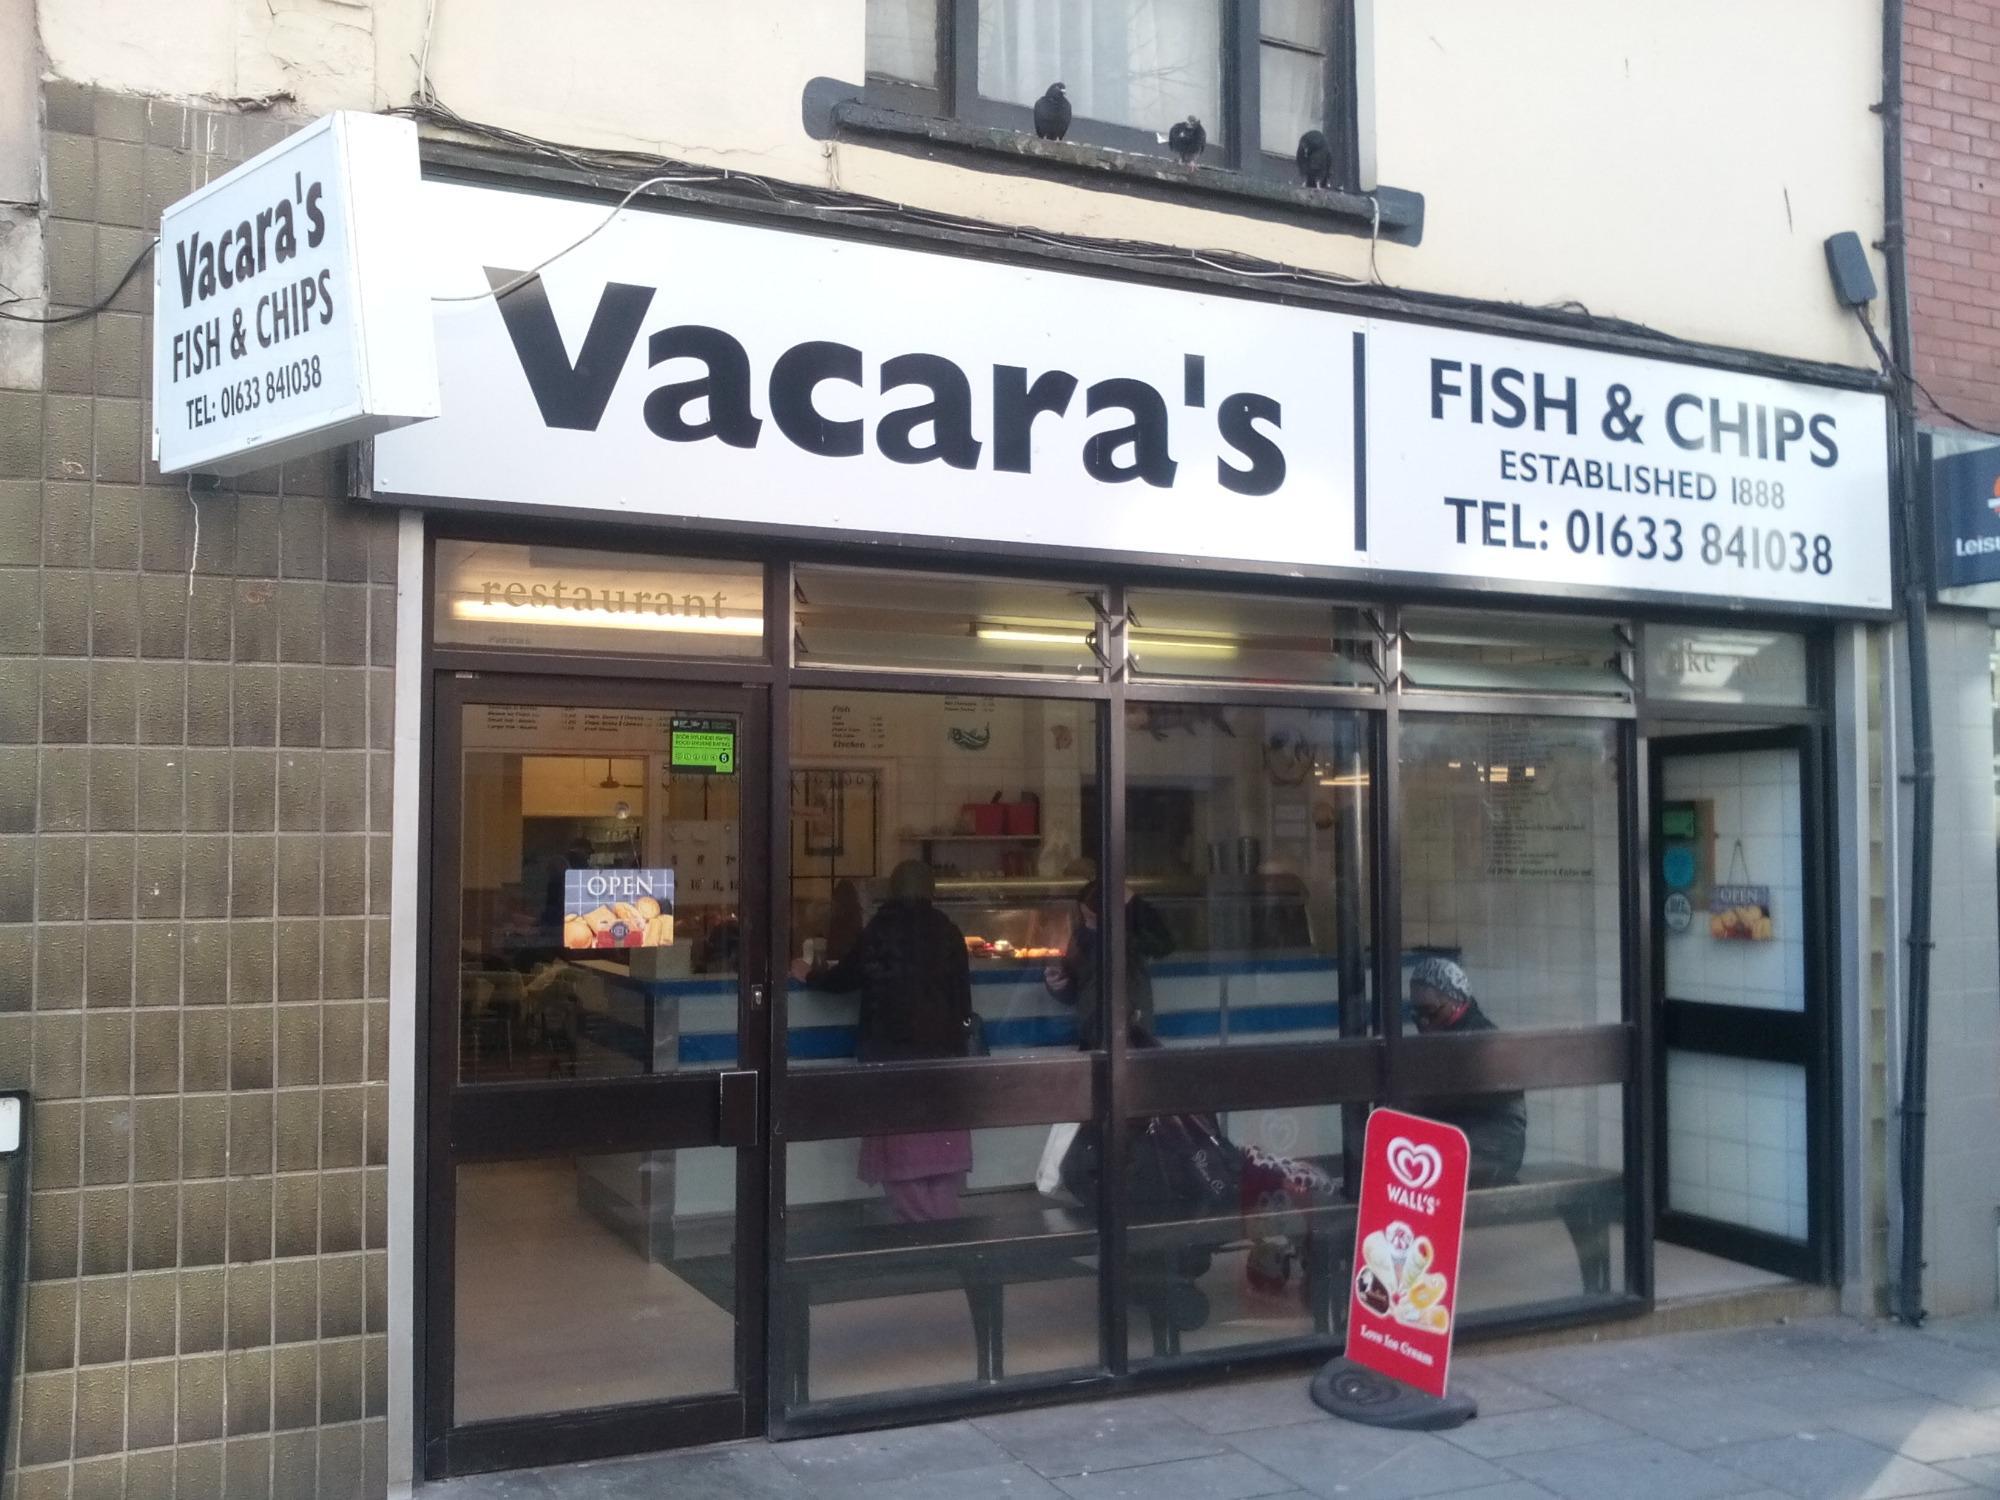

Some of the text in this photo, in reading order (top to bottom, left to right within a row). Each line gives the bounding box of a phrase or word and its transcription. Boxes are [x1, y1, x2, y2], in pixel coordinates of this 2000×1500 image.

[176, 172, 325, 308] Vacara's
[173, 268, 333, 383] FISH & CHIPS
[186, 354, 322, 430] TEL: 01633 841038
[483, 266, 1287, 496] Vacara's
[1430, 357, 1839, 469] FISH & CHIPS
[1500, 449, 1785, 509] ESTABLISHED 1888
[1443, 496, 1834, 576] TEL: 01633 841038
[481, 579, 727, 620] restaurant
[586, 874, 653, 896] OPEN
[1386, 1183, 1436, 1217] WALL'S
